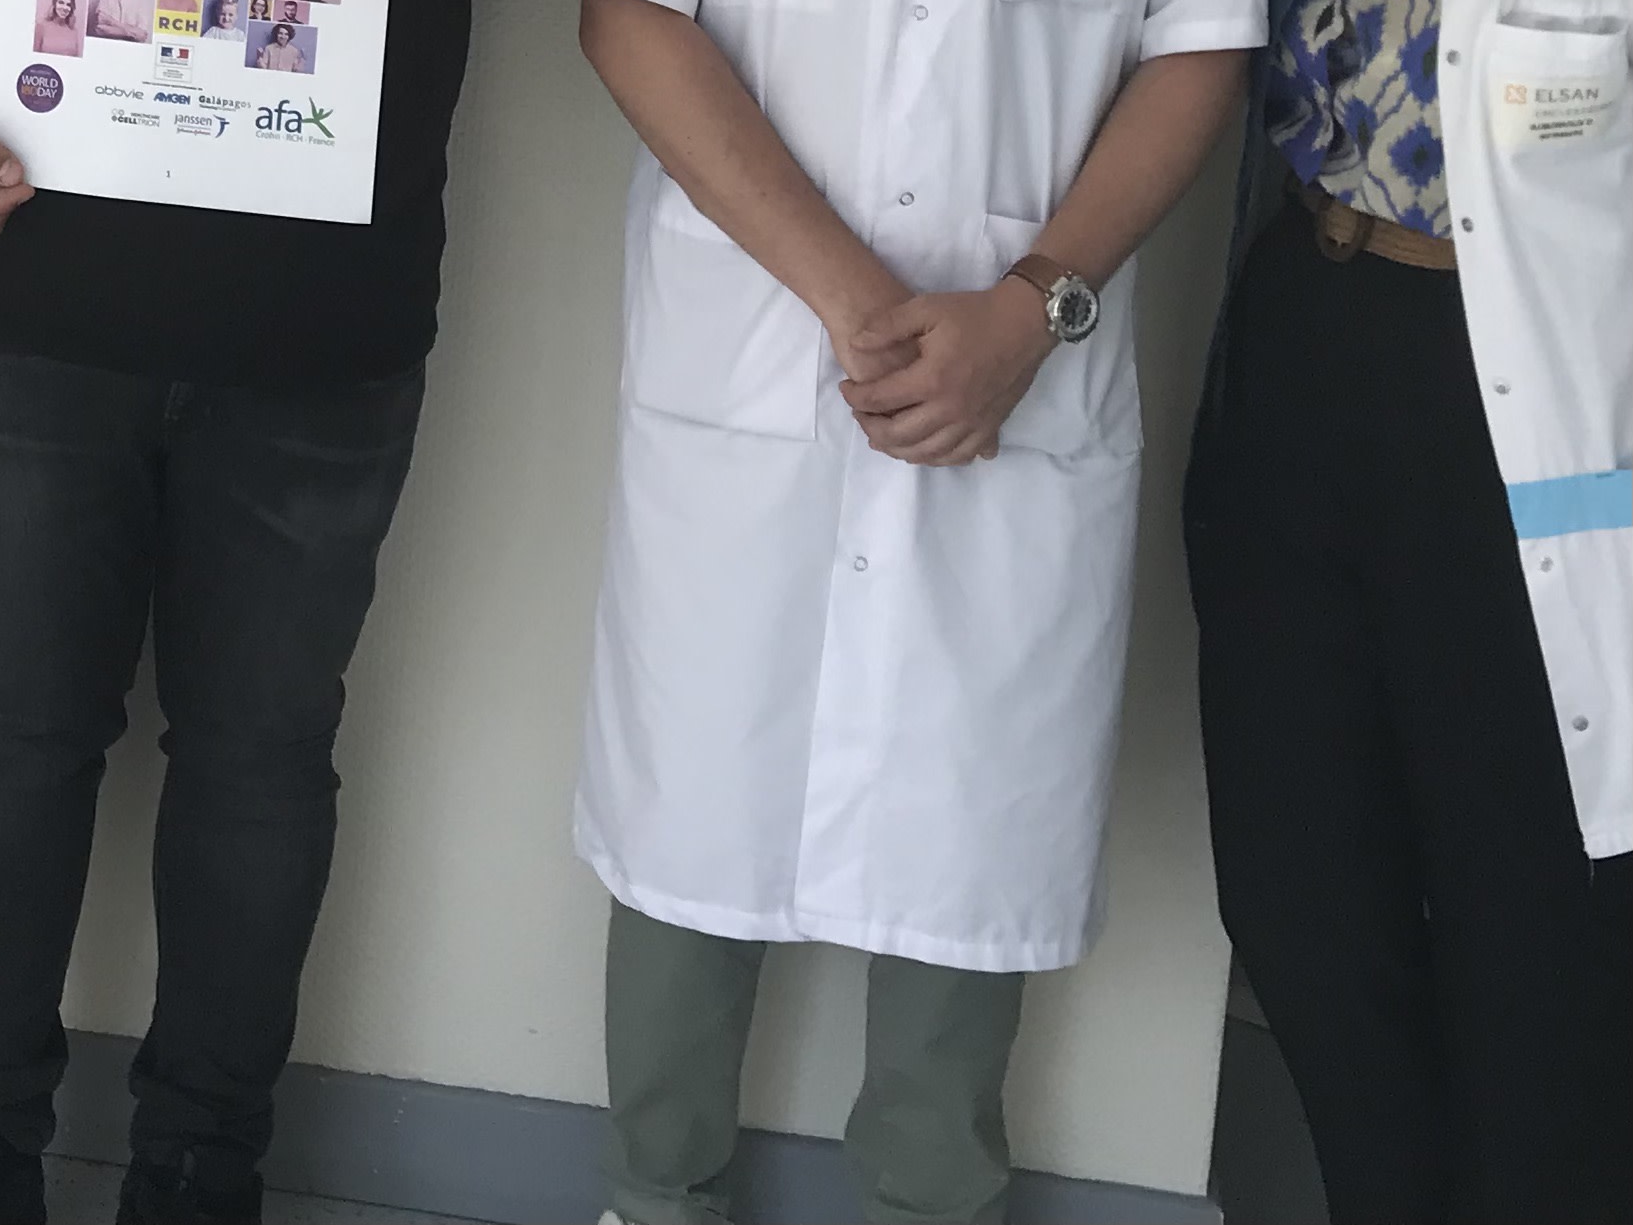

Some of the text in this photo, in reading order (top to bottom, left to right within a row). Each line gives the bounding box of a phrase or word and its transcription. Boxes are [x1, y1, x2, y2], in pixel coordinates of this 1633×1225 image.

[159, 16, 198, 32] RCH
[21, 75, 58, 88] WORLD
[95, 85, 144, 100] abbvie
[153, 92, 191, 105] AMGEN
[1535, 88, 1599, 103] ELSAN
[198, 95, 251, 109] Galápagos
[174, 114, 213, 126] janssen
[255, 99, 303, 134] afa
